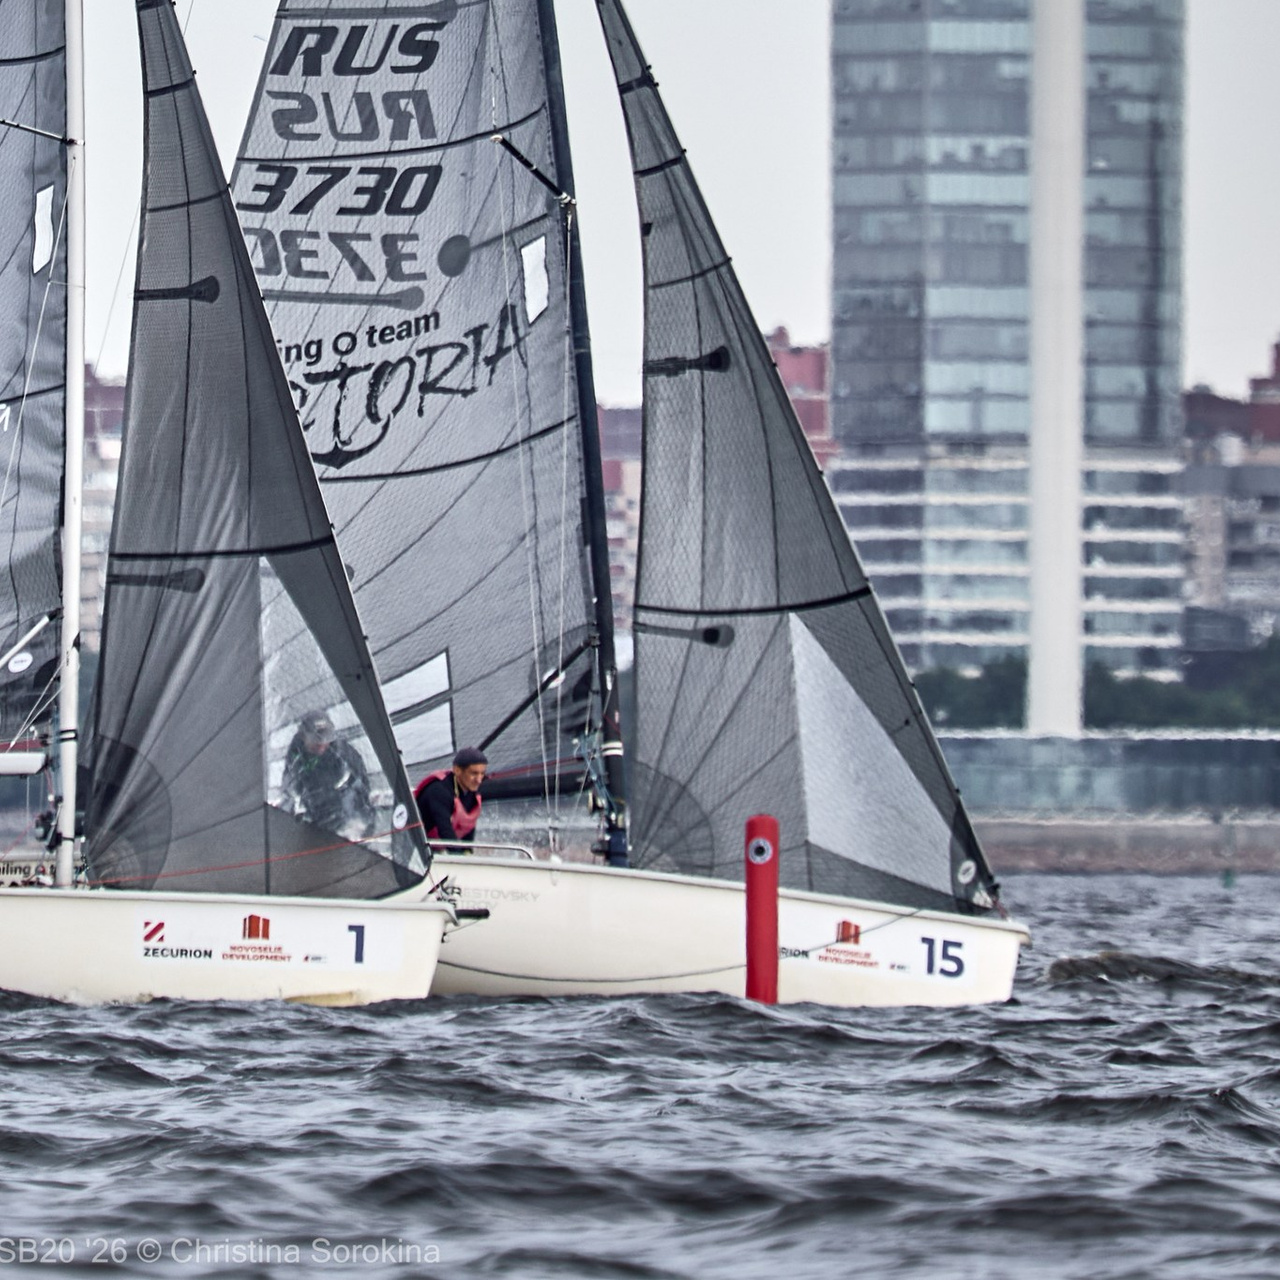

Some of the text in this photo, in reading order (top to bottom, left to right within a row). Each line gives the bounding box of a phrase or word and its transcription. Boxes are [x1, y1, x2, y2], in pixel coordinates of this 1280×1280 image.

[268, 21, 450, 77] RUS
[236, 164, 443, 217] 3730
[366, 311, 440, 347] team
[289, 302, 529, 446] TORIA
[143, 948, 213, 959] ZECURION
[222, 953, 292, 962] DEVELOPMENT
[348, 924, 365, 963] 1
[780, 946, 810, 959] RION
[921, 936, 966, 978] 15
